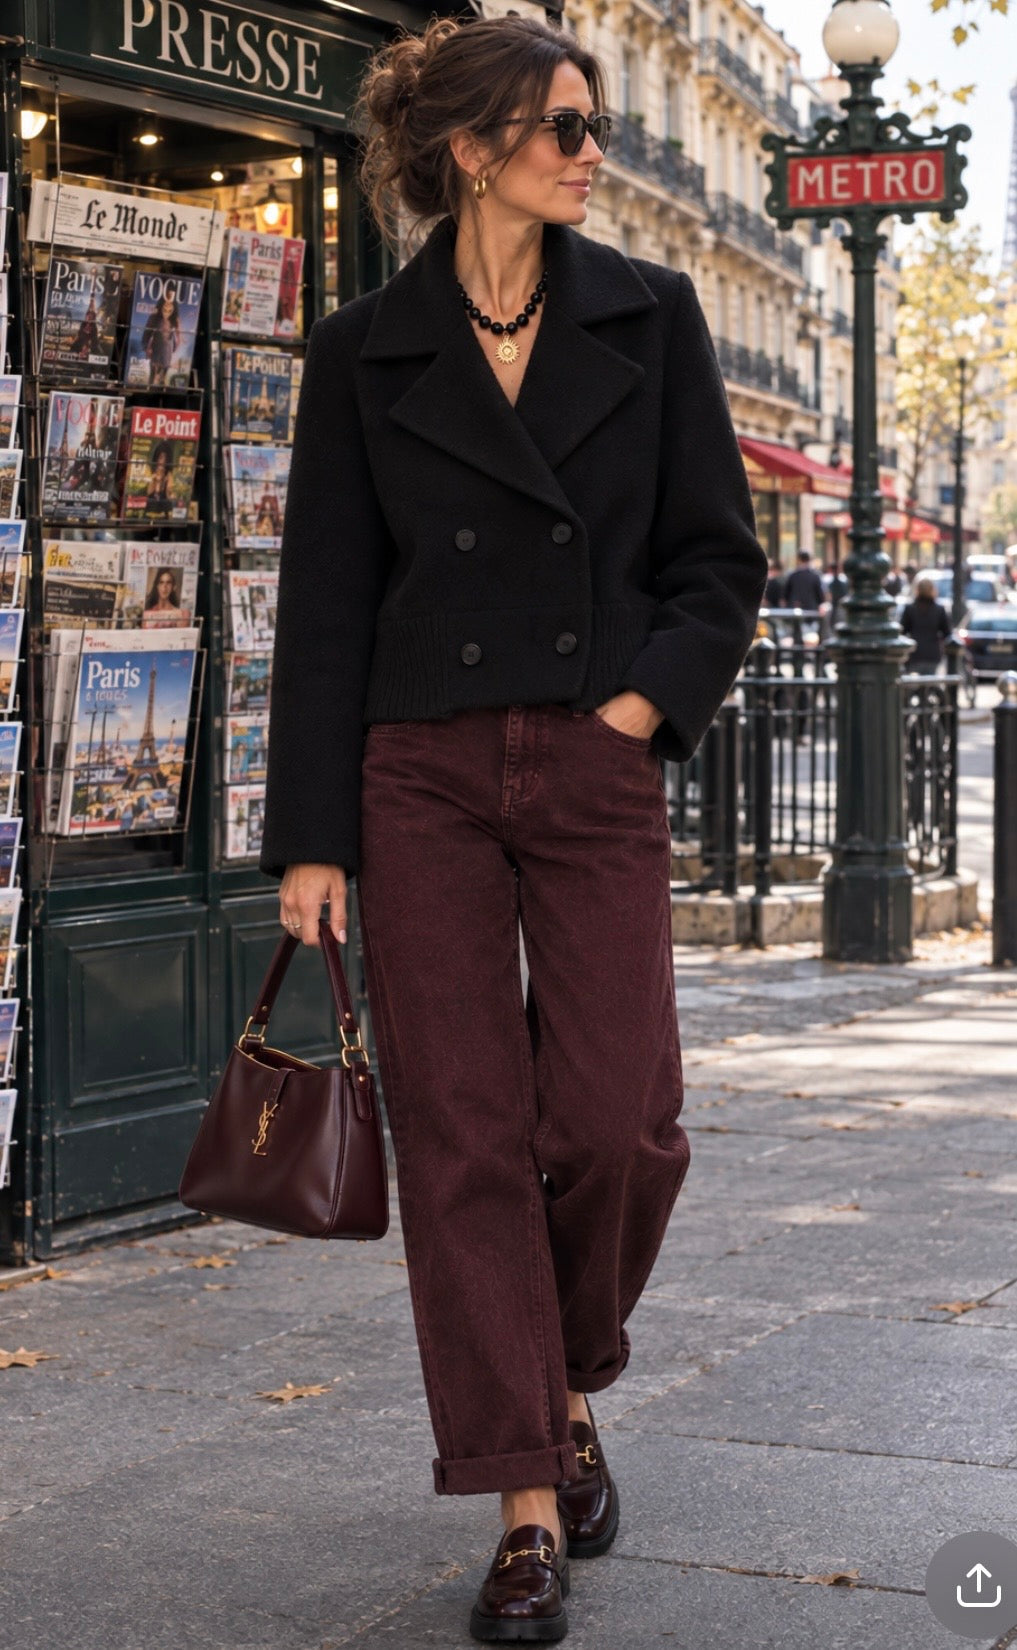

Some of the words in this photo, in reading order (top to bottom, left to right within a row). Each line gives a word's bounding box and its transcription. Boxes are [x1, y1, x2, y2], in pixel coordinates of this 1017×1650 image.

[118, 0, 323, 100] PRESSE
[796, 158, 937, 201] METRO
[79, 199, 107, 231] Le
[110, 202, 188, 242] Monde
[53, 261, 105, 295] Paris
[139, 274, 202, 306] VOGUE
[134, 412, 152, 434] Le
[155, 413, 198, 437] Point
[86, 660, 141, 689] Paris
